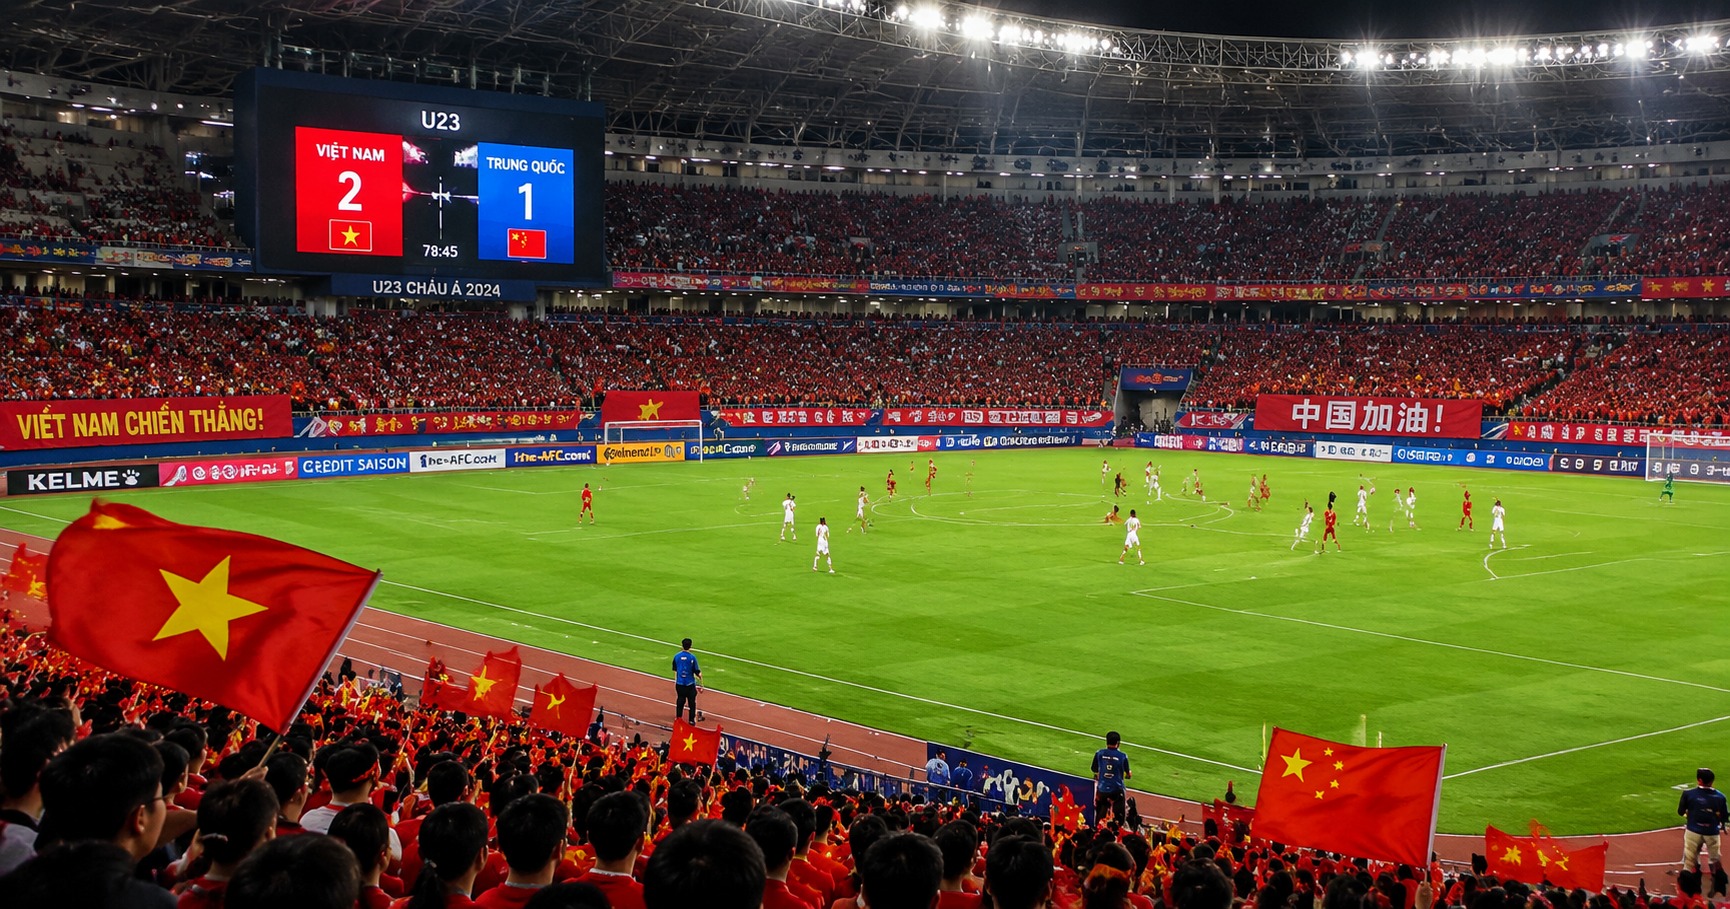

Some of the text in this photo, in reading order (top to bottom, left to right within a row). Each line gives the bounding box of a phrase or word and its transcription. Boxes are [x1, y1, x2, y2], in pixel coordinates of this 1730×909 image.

[421, 110, 461, 131] U23
[315, 141, 385, 162] VIỆT NAM
[486, 156, 528, 172] TRUNG
[337, 170, 363, 212] 2
[518, 182, 533, 221] 1
[422, 244, 459, 258] 78:45
[372, 280, 402, 294] U23
[465, 283, 501, 298] 2024
[72, 411, 120, 438] NAM
[1291, 398, 1444, 433] 中国加油!
[302, 457, 407, 474] CREDIT SAISON
[27, 470, 121, 491] KELME
